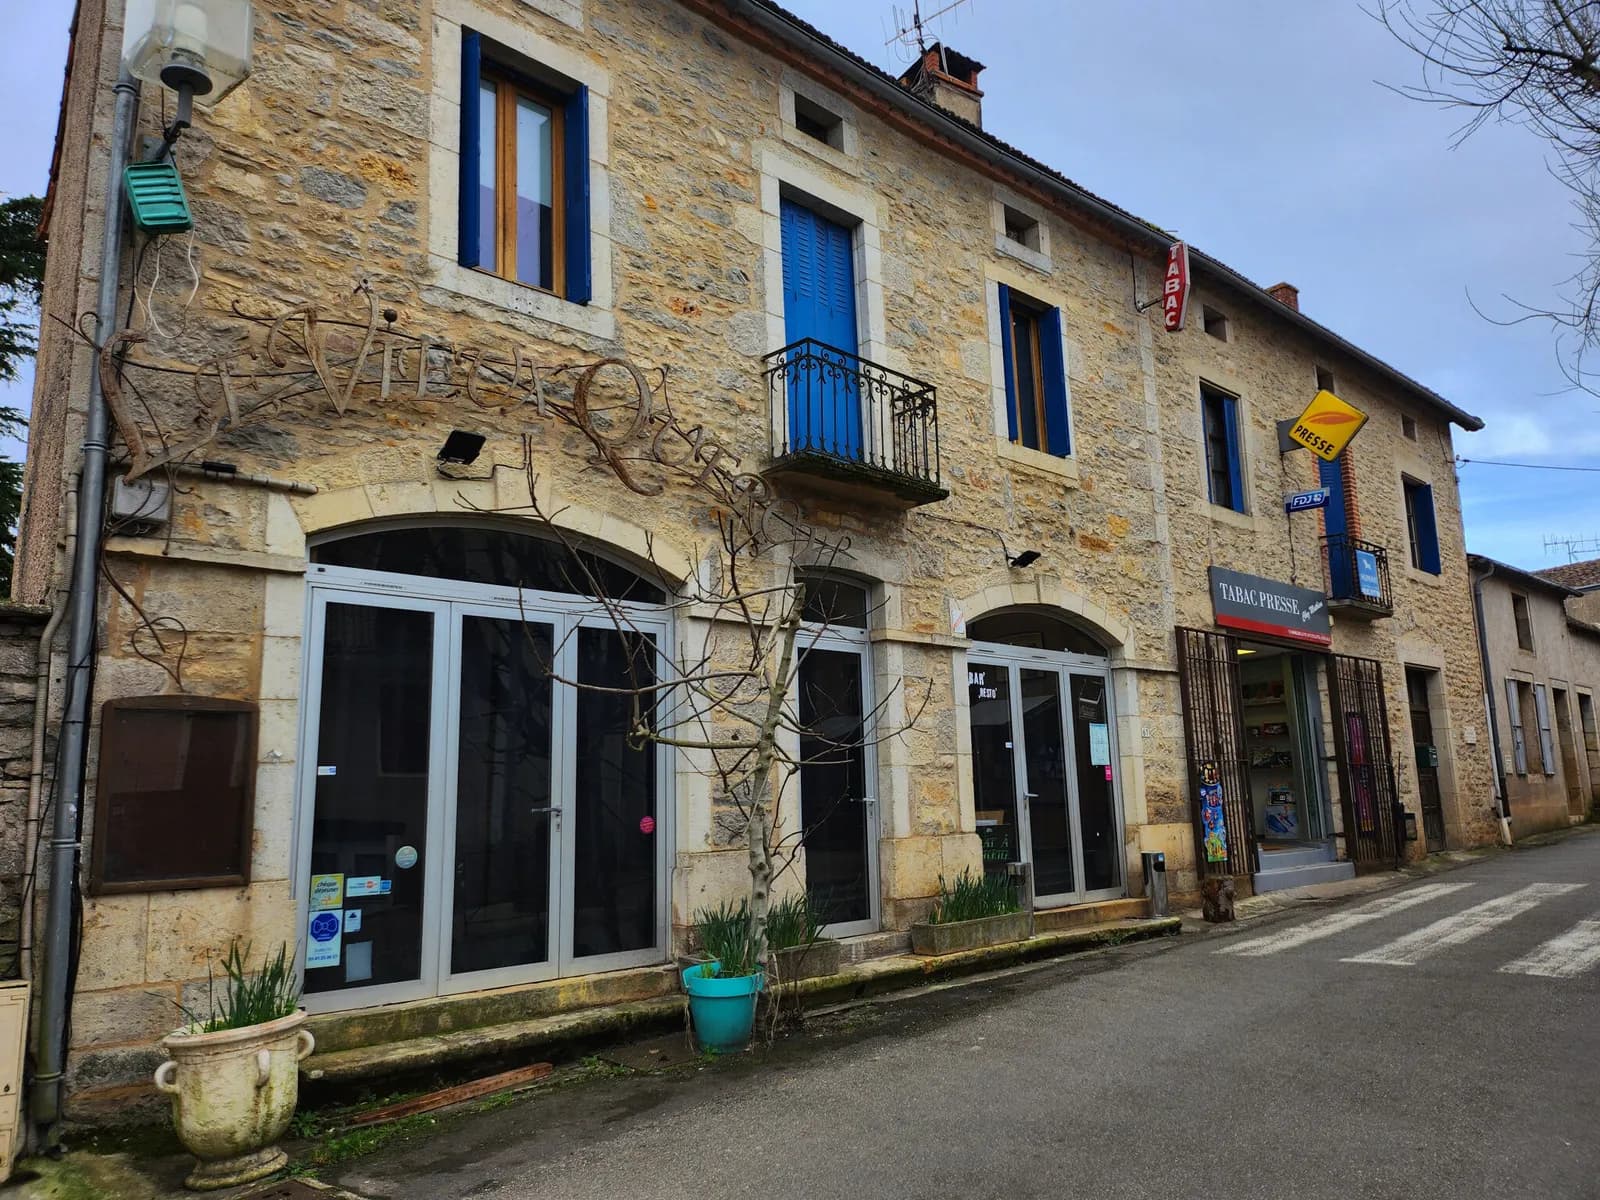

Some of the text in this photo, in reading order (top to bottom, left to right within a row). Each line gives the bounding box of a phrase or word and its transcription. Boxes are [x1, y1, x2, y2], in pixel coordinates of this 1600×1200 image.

[1165, 245, 1180, 326] TABAC
[1294, 425, 1335, 455] PRESSE
[1293, 493, 1312, 506] FDJ
[1219, 582, 1258, 606] TABAC
[1259, 591, 1300, 615] PRESSE
[968, 671, 985, 686] BAR
